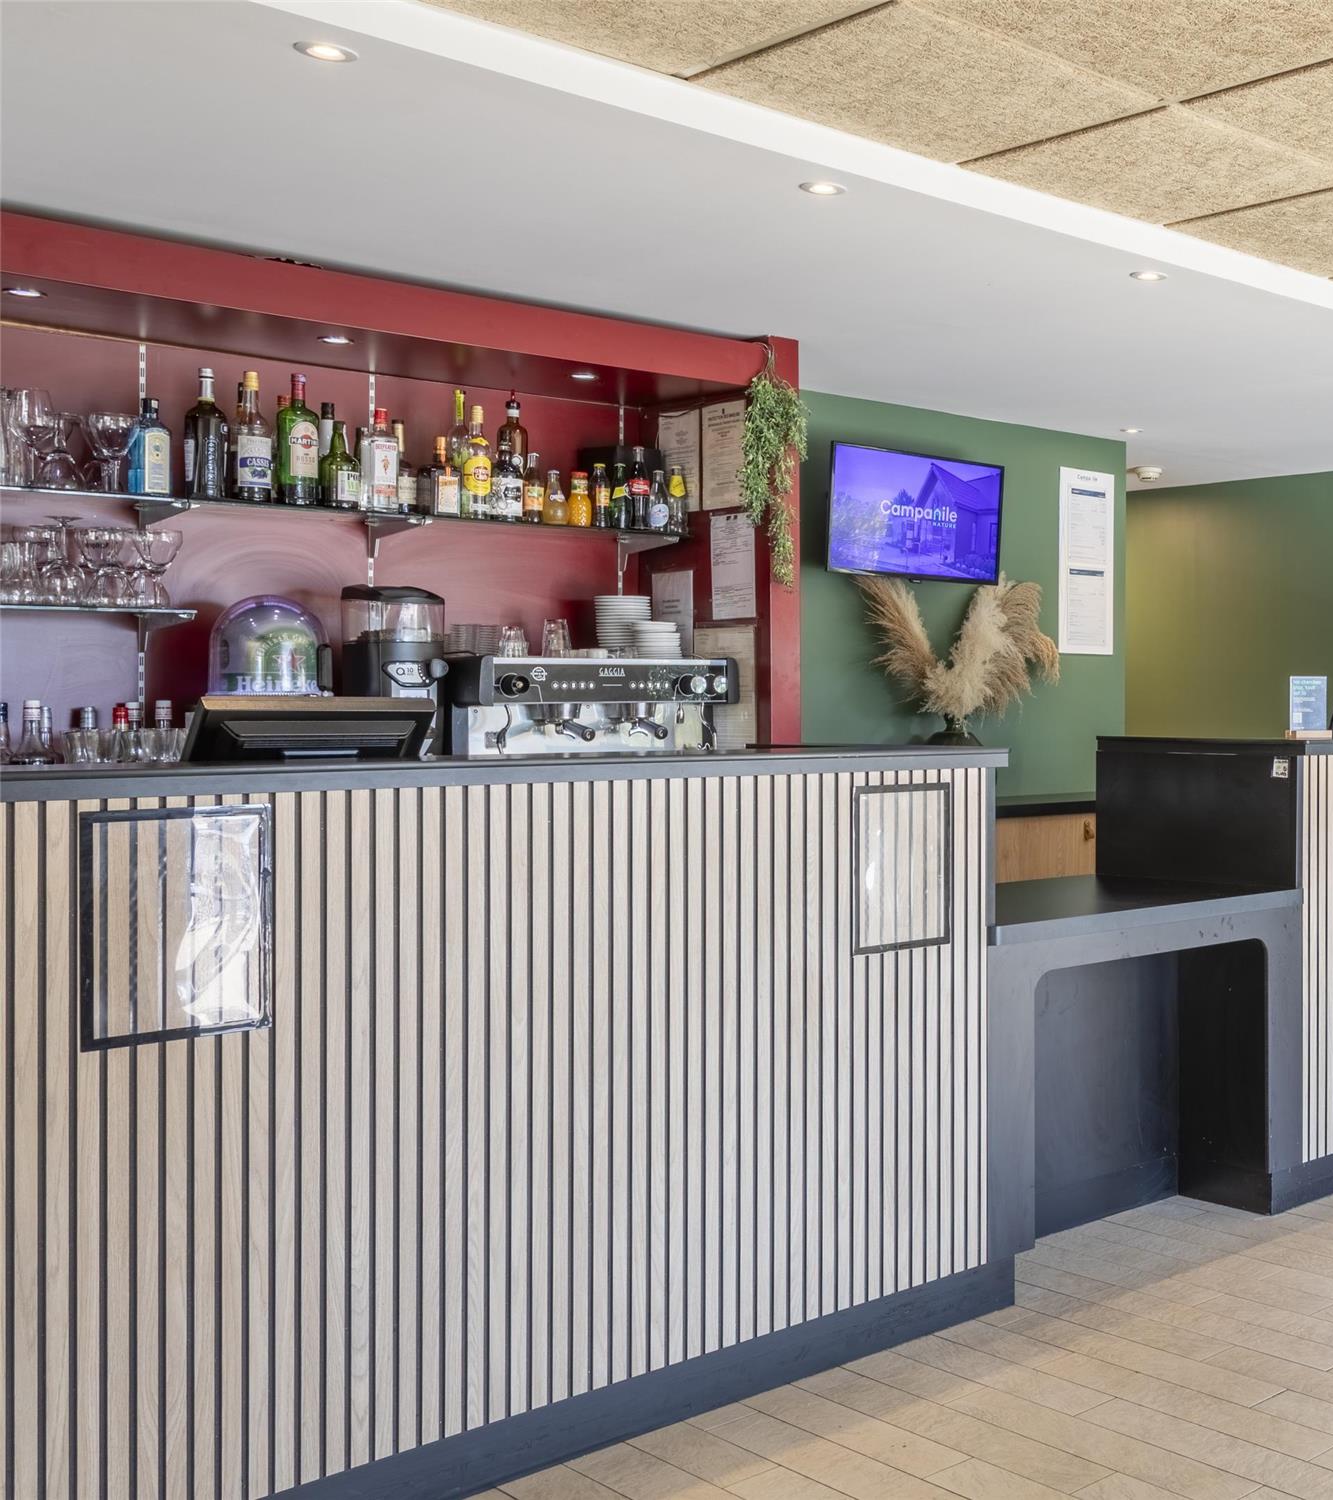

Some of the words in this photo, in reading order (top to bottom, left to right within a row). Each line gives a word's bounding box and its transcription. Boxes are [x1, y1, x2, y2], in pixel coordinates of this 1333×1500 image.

[247, 458, 270, 469] CASSIS
[880, 500, 958, 523] Campanile
[599, 668, 625, 676] GAGGIA
[236, 675, 319, 692] Heineke
